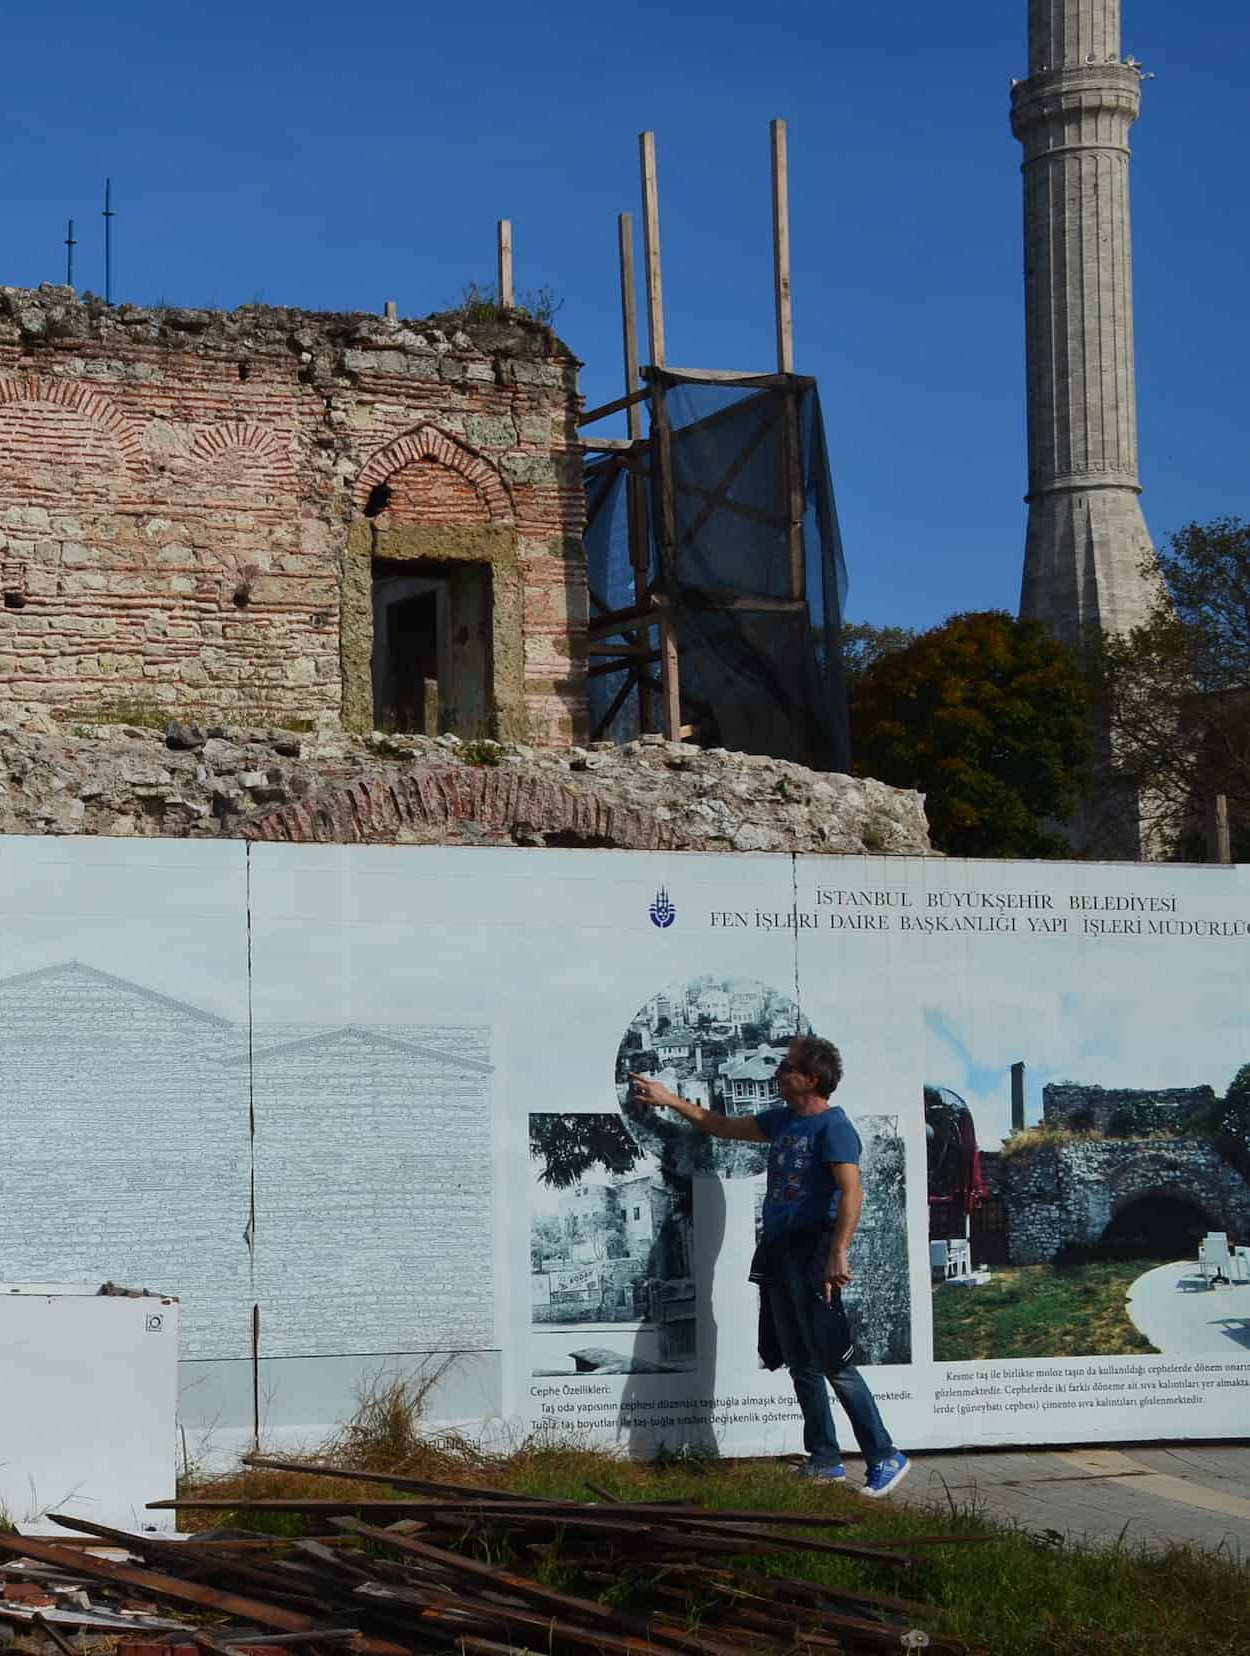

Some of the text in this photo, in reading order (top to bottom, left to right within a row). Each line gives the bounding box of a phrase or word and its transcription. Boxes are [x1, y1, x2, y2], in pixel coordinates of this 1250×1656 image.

[816, 886, 1177, 912] İSTANBUL BÜYÜKŞEHİR BELEDİYESİ
[710, 912, 750, 927] FEN
[754, 908, 818, 931] İŞLERİ
[830, 910, 890, 930] DAİRE
[900, 913, 1016, 934] BAŞKANLIĞI
[1027, 917, 1068, 932] YAPI
[1082, 915, 1142, 936] İŞLERİ
[946, 1372, 974, 1381] Kesme
[976, 1371, 988, 1382] taş
[990, 1369, 1000, 1379] ile
[1003, 1368, 1034, 1378] birlikte
[1064, 1366, 1084, 1378] taşın
[1086, 1366, 1096, 1376] da
[1098, 1364, 1146, 1377] kullanıldığı
[1148, 1363, 1192, 1376] cephelerde
[1194, 1362, 1222, 1372] dönem
[530, 1384, 610, 1398] Cephe Özellikleri:
[934, 1387, 1001, 1401] gözlenmektedir.
[1004, 1384, 1054, 1396] Cephelerde
[1056, 1383, 1066, 1393] iki
[1068, 1382, 1090, 1392] farklı
[1092, 1382, 1125, 1392] döneme
[1128, 1380, 1138, 1390] ait
[1140, 1382, 1156, 1390] sıva
[1158, 1379, 1198, 1389] kalıntıları
[1201, 1381, 1214, 1390] yer
[541, 1403, 554, 1414] Taş
[558, 1403, 574, 1413] oda
[576, 1402, 618, 1414] yapısının
[742, 1396, 775, 1408] almaşık
[1004, 1400, 1039, 1413] cephesi)
[1042, 1399, 1076, 1411] çimento
[1096, 1396, 1137, 1408] kalıntıları
[1140, 1394, 1206, 1408] gözlenmektedir.
[561, 1420, 574, 1430] taş
[708, 1412, 760, 1426] değişkenlik
